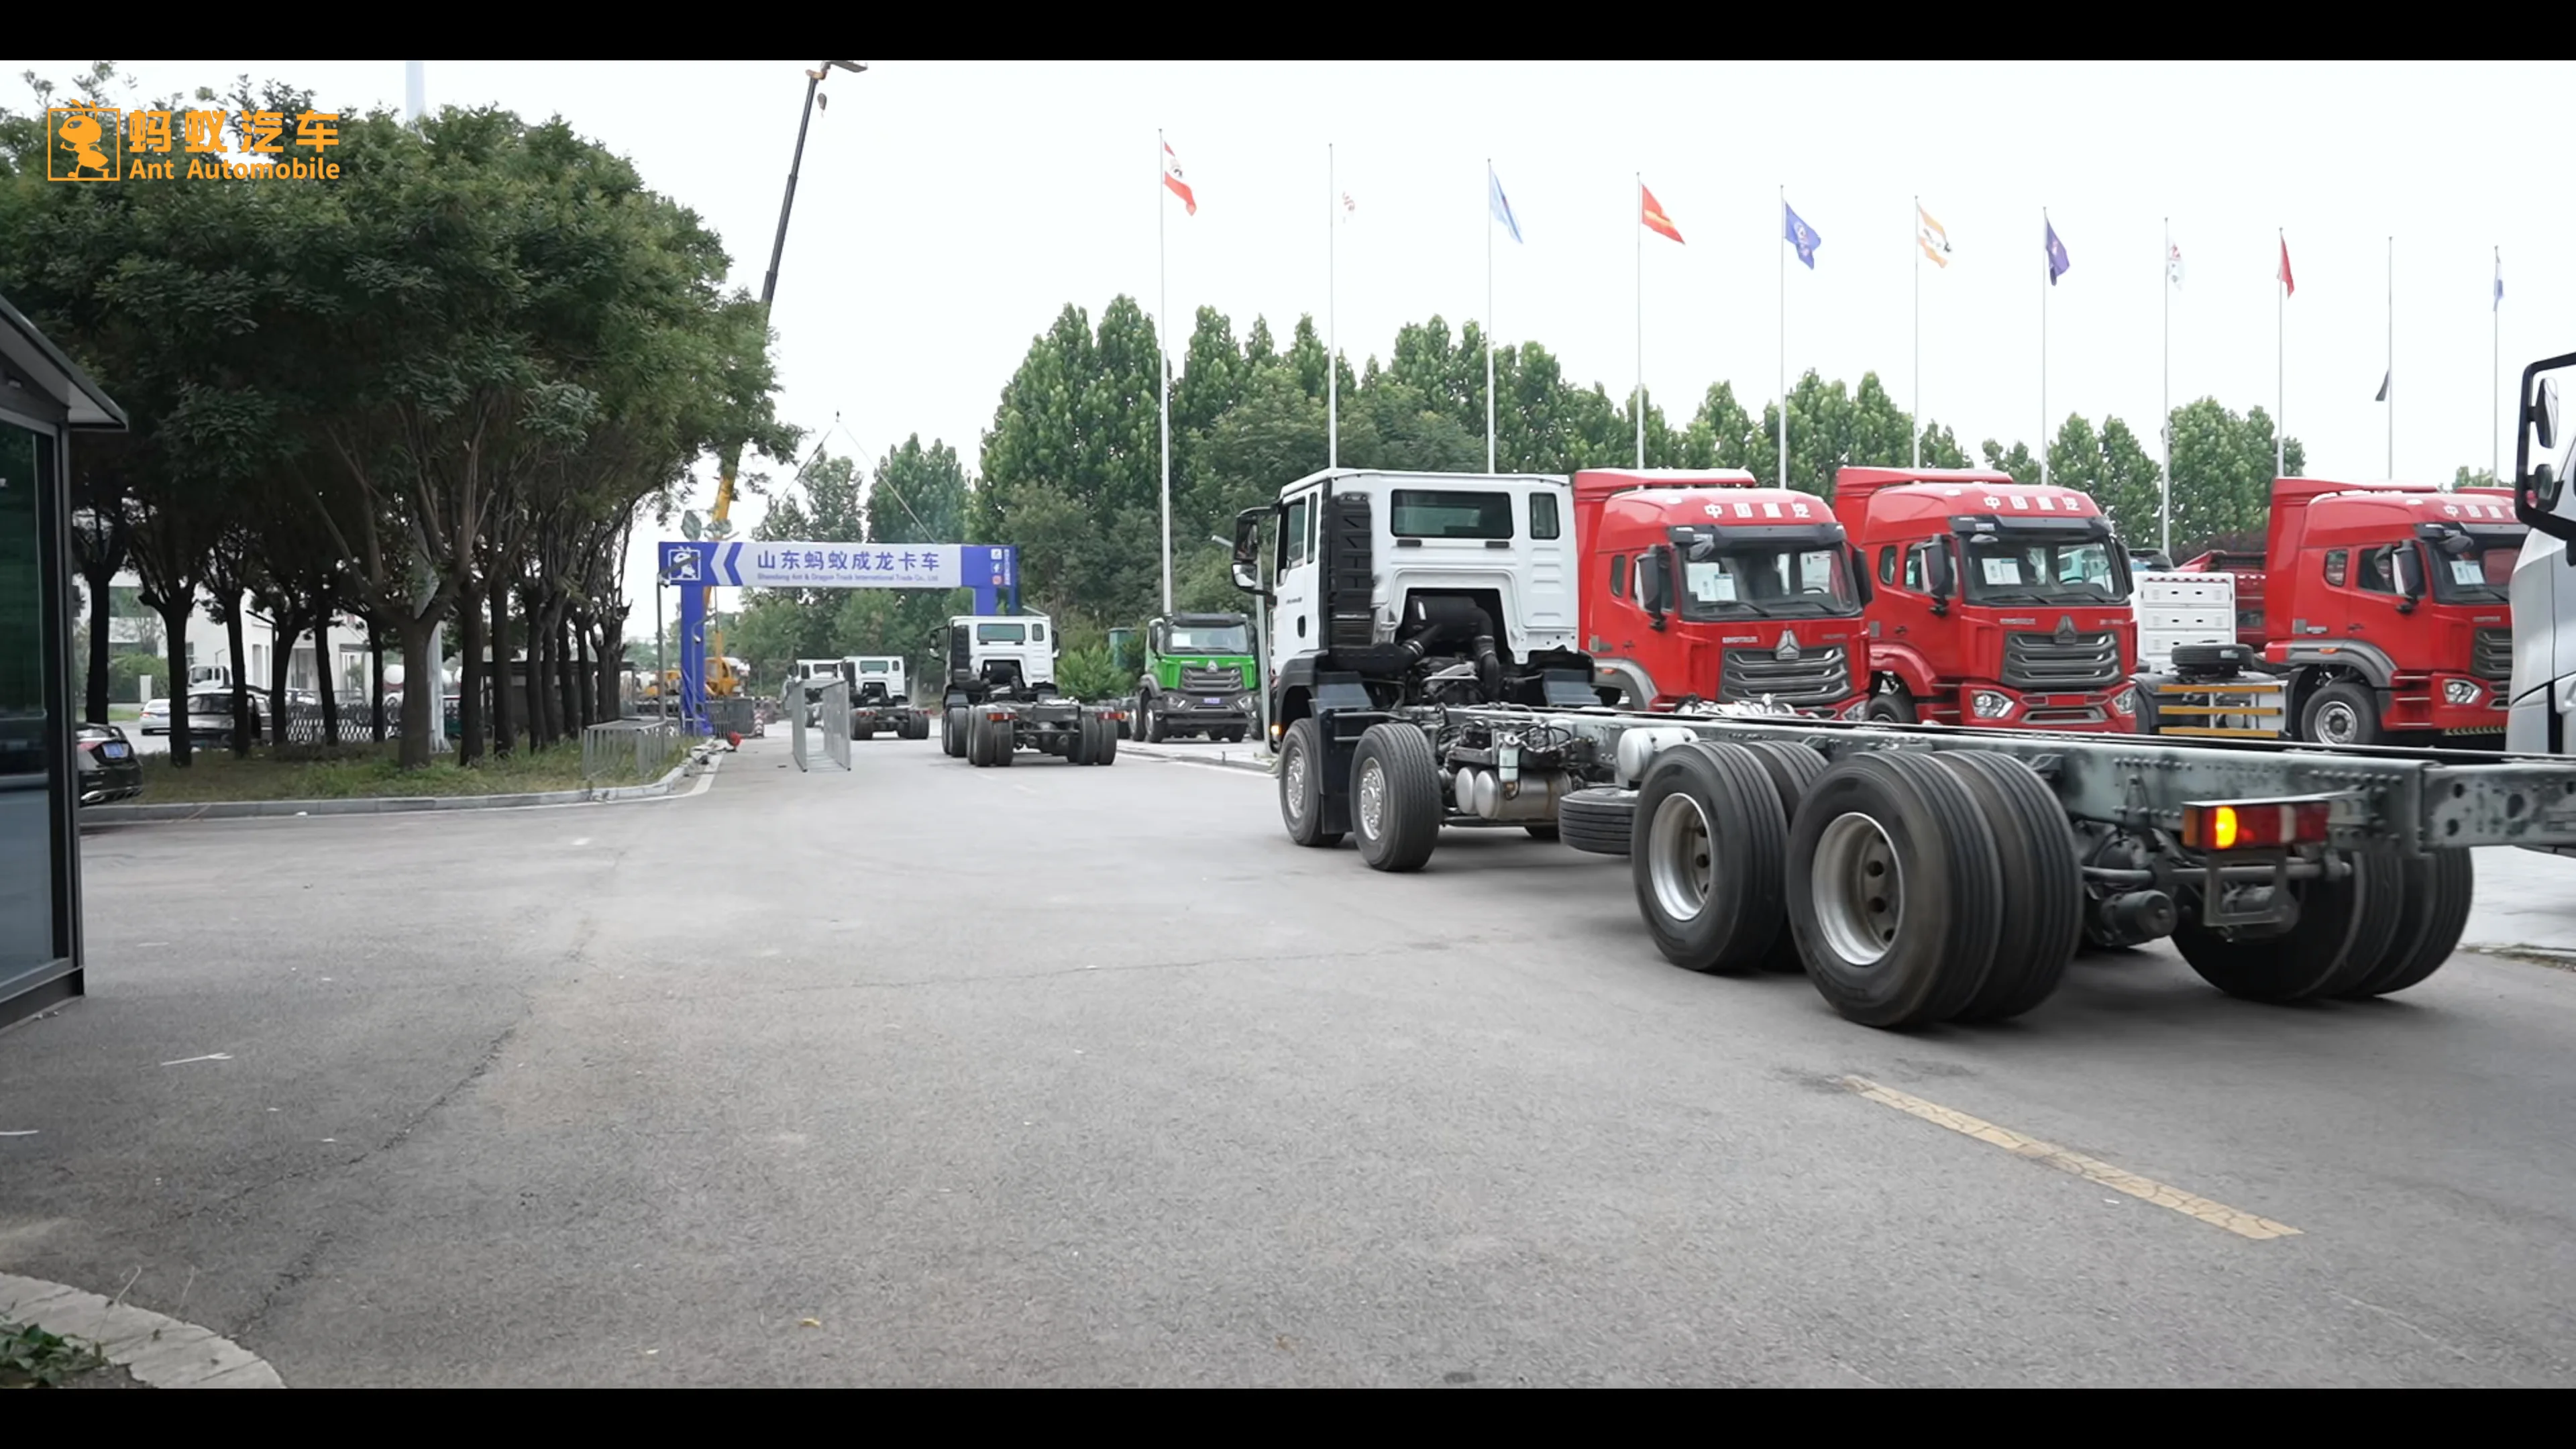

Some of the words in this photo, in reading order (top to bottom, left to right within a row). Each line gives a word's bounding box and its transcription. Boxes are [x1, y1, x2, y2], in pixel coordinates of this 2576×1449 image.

[757, 550, 940, 572] 山东蚂蚁成龙卡车
